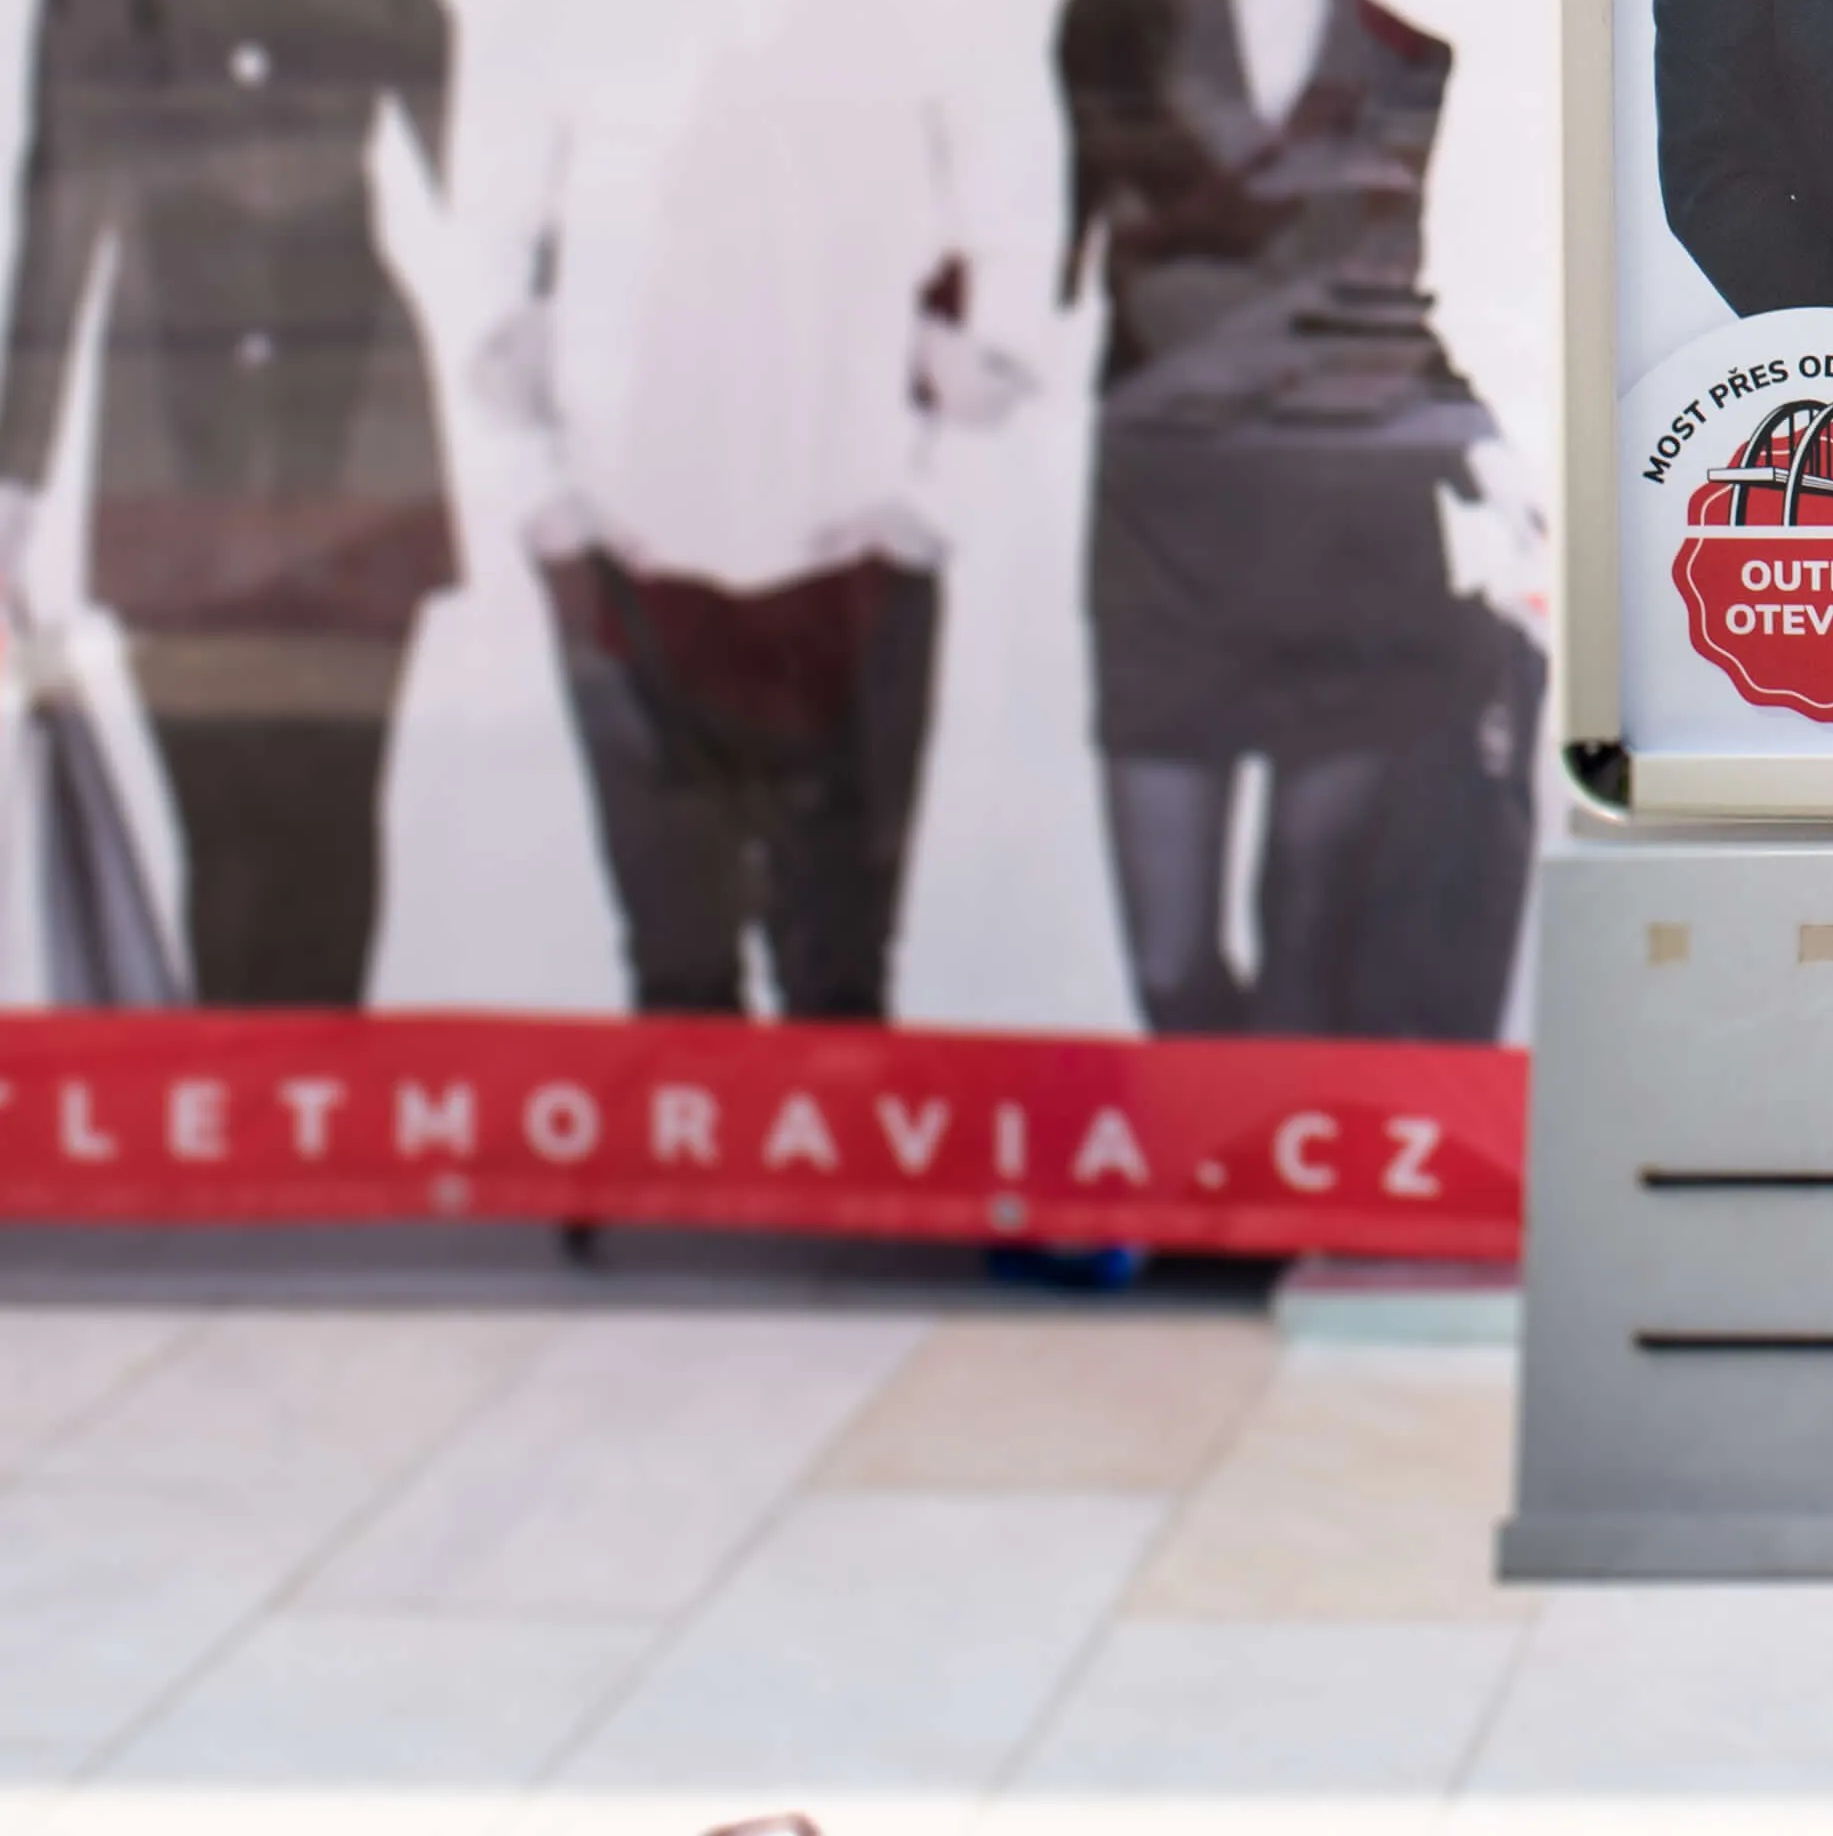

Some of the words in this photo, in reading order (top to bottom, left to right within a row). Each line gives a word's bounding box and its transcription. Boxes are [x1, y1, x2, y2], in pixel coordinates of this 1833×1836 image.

[1642, 400, 1707, 484] MOST
[1708, 359, 1789, 409] PŘES
[0, 1076, 1443, 1198] LETMORAVIA.CZ
